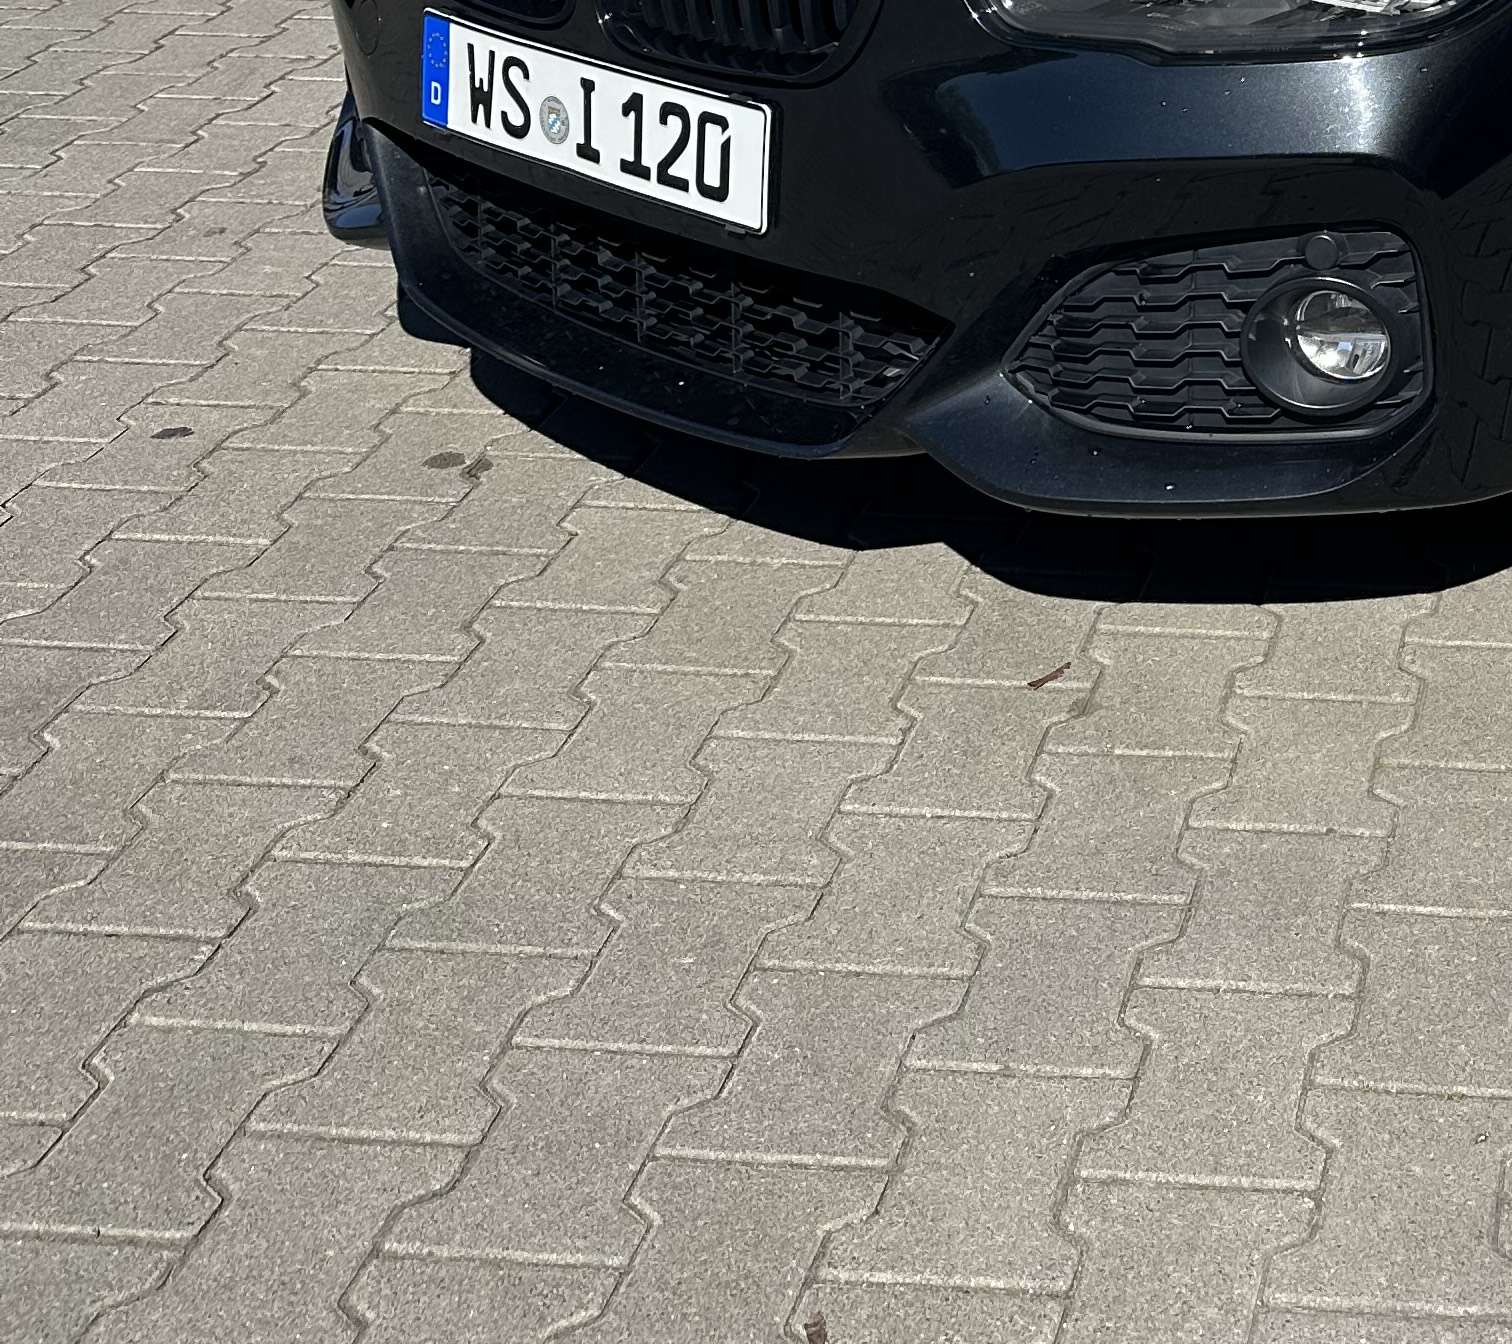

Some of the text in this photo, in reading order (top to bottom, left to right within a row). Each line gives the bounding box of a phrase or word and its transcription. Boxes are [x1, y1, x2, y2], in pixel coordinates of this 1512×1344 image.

[430, 81, 442, 106] D
[467, 42, 732, 203] WS I 120
